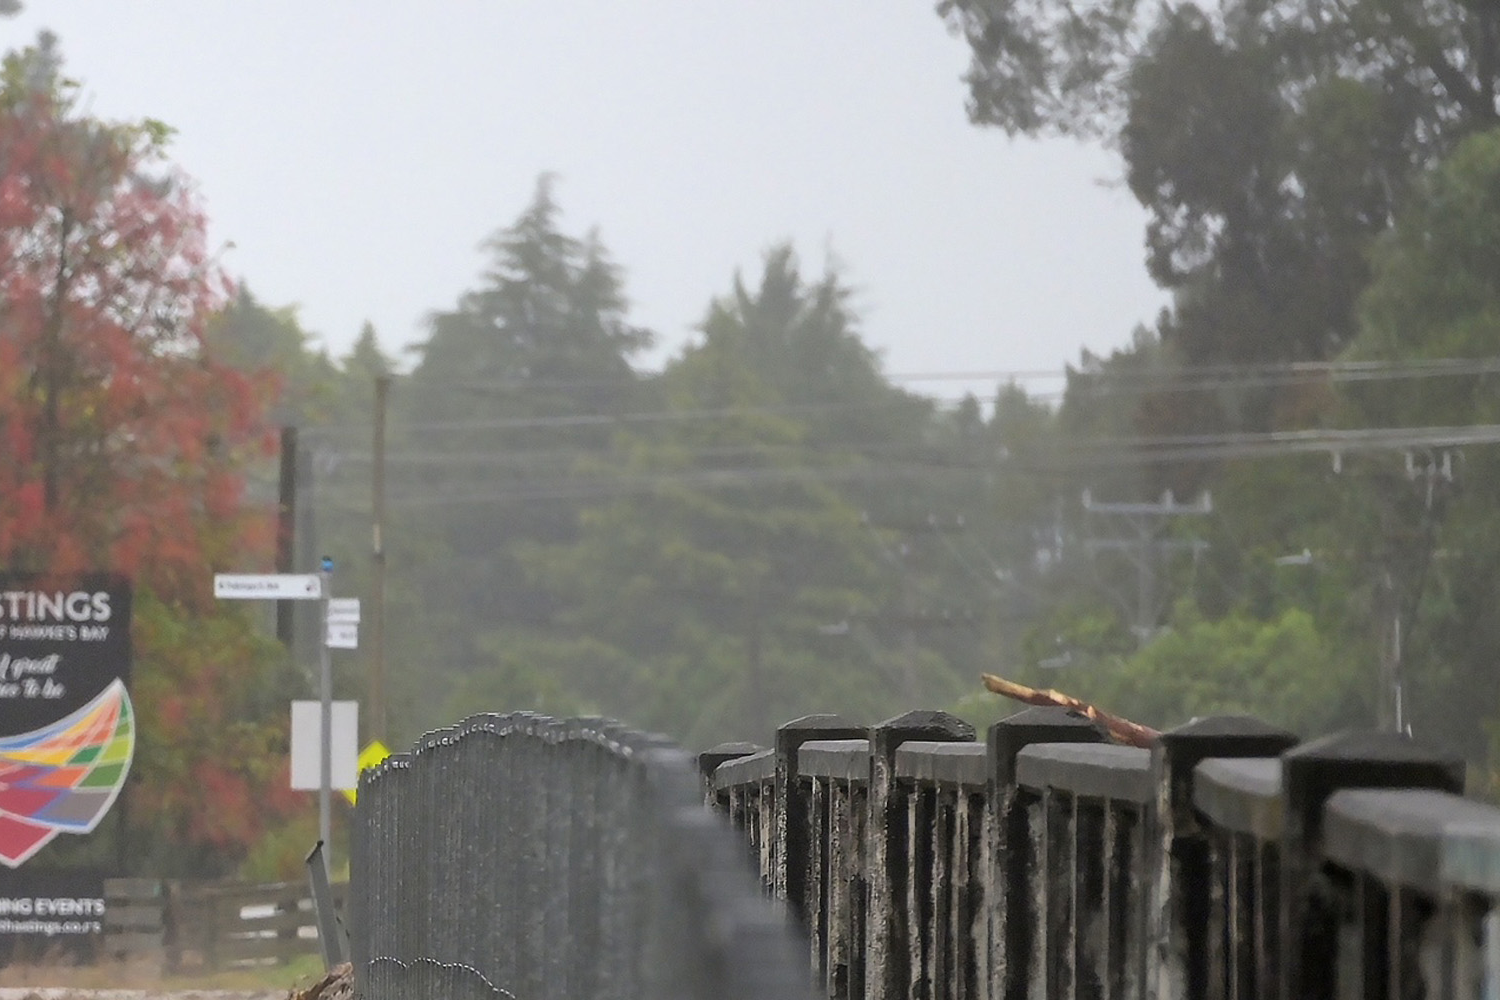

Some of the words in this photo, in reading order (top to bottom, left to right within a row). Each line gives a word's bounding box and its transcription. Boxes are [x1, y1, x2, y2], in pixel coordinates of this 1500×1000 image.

[9, 624, 77, 641] HAWKE'S
[79, 625, 109, 641] BAY
[11, 653, 62, 680] great
[22, 676, 41, 699] to
[41, 676, 66, 699] be
[34, 897, 105, 916] EVENTS
